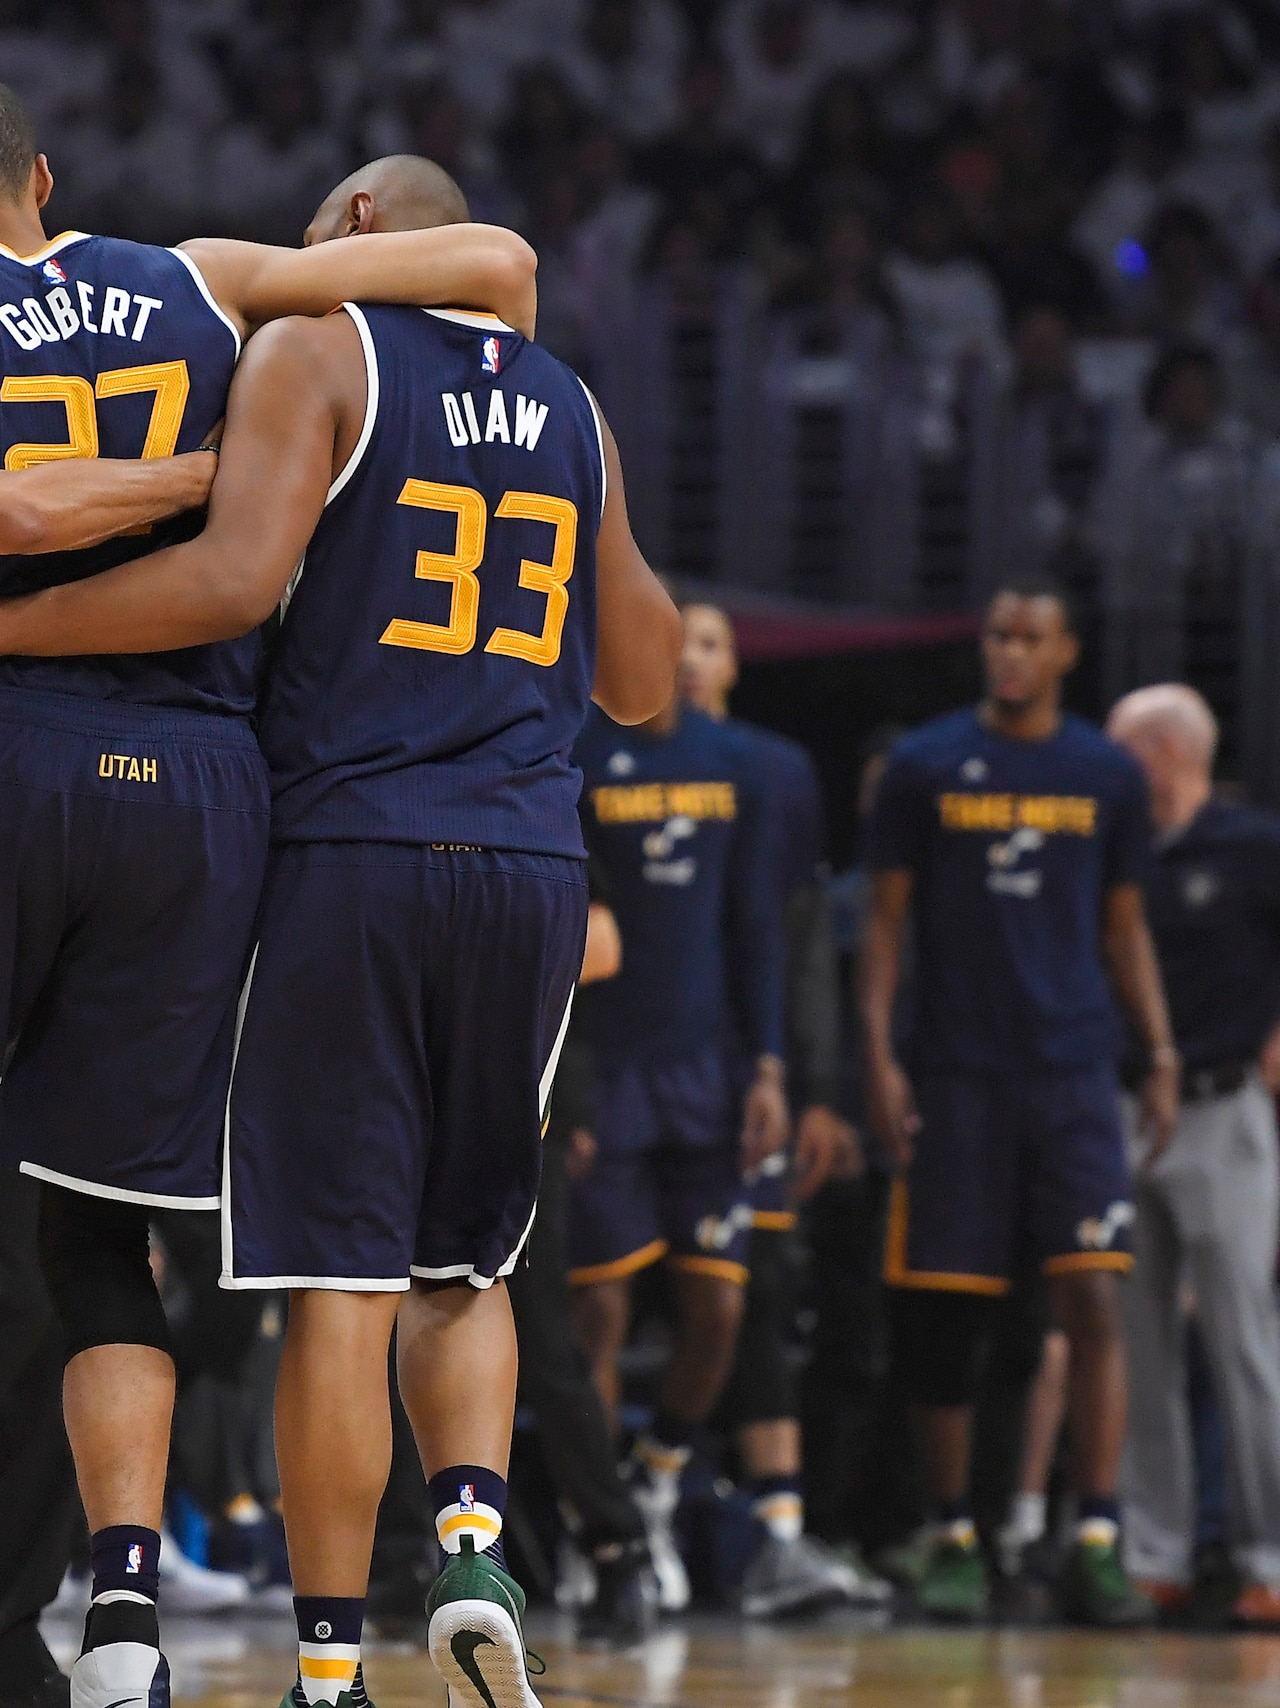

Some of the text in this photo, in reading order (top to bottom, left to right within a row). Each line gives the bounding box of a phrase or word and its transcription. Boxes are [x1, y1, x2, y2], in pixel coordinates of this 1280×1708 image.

[0, 360, 190, 471] 27
[441, 388, 550, 451] DIAW
[378, 478, 578, 667] 33
[99, 753, 157, 783] UTAH
